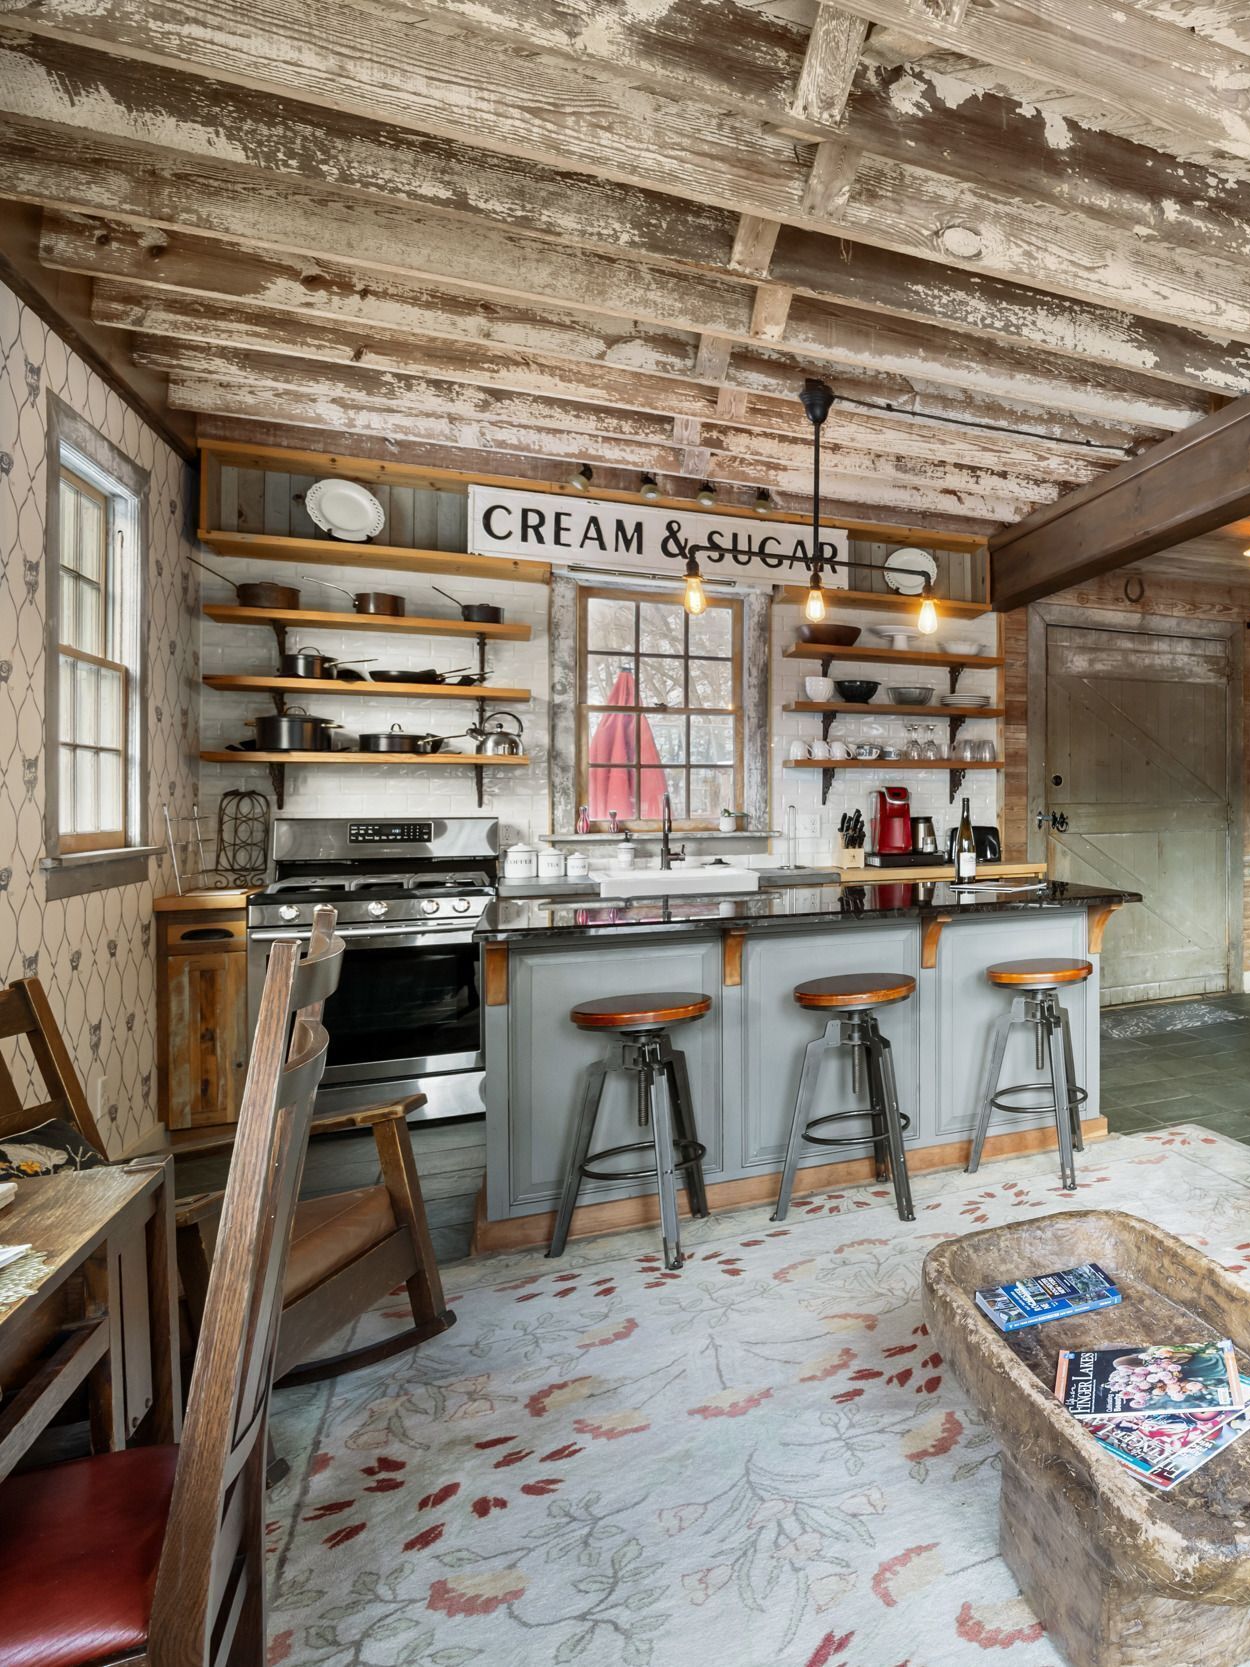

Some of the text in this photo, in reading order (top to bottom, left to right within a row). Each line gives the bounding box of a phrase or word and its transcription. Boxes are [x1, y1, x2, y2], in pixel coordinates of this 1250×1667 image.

[482, 504, 838, 574] CREAM & SUGAR
[1072, 1352, 1095, 1380] LAKES
[1068, 1380, 1092, 1413] FINGER
